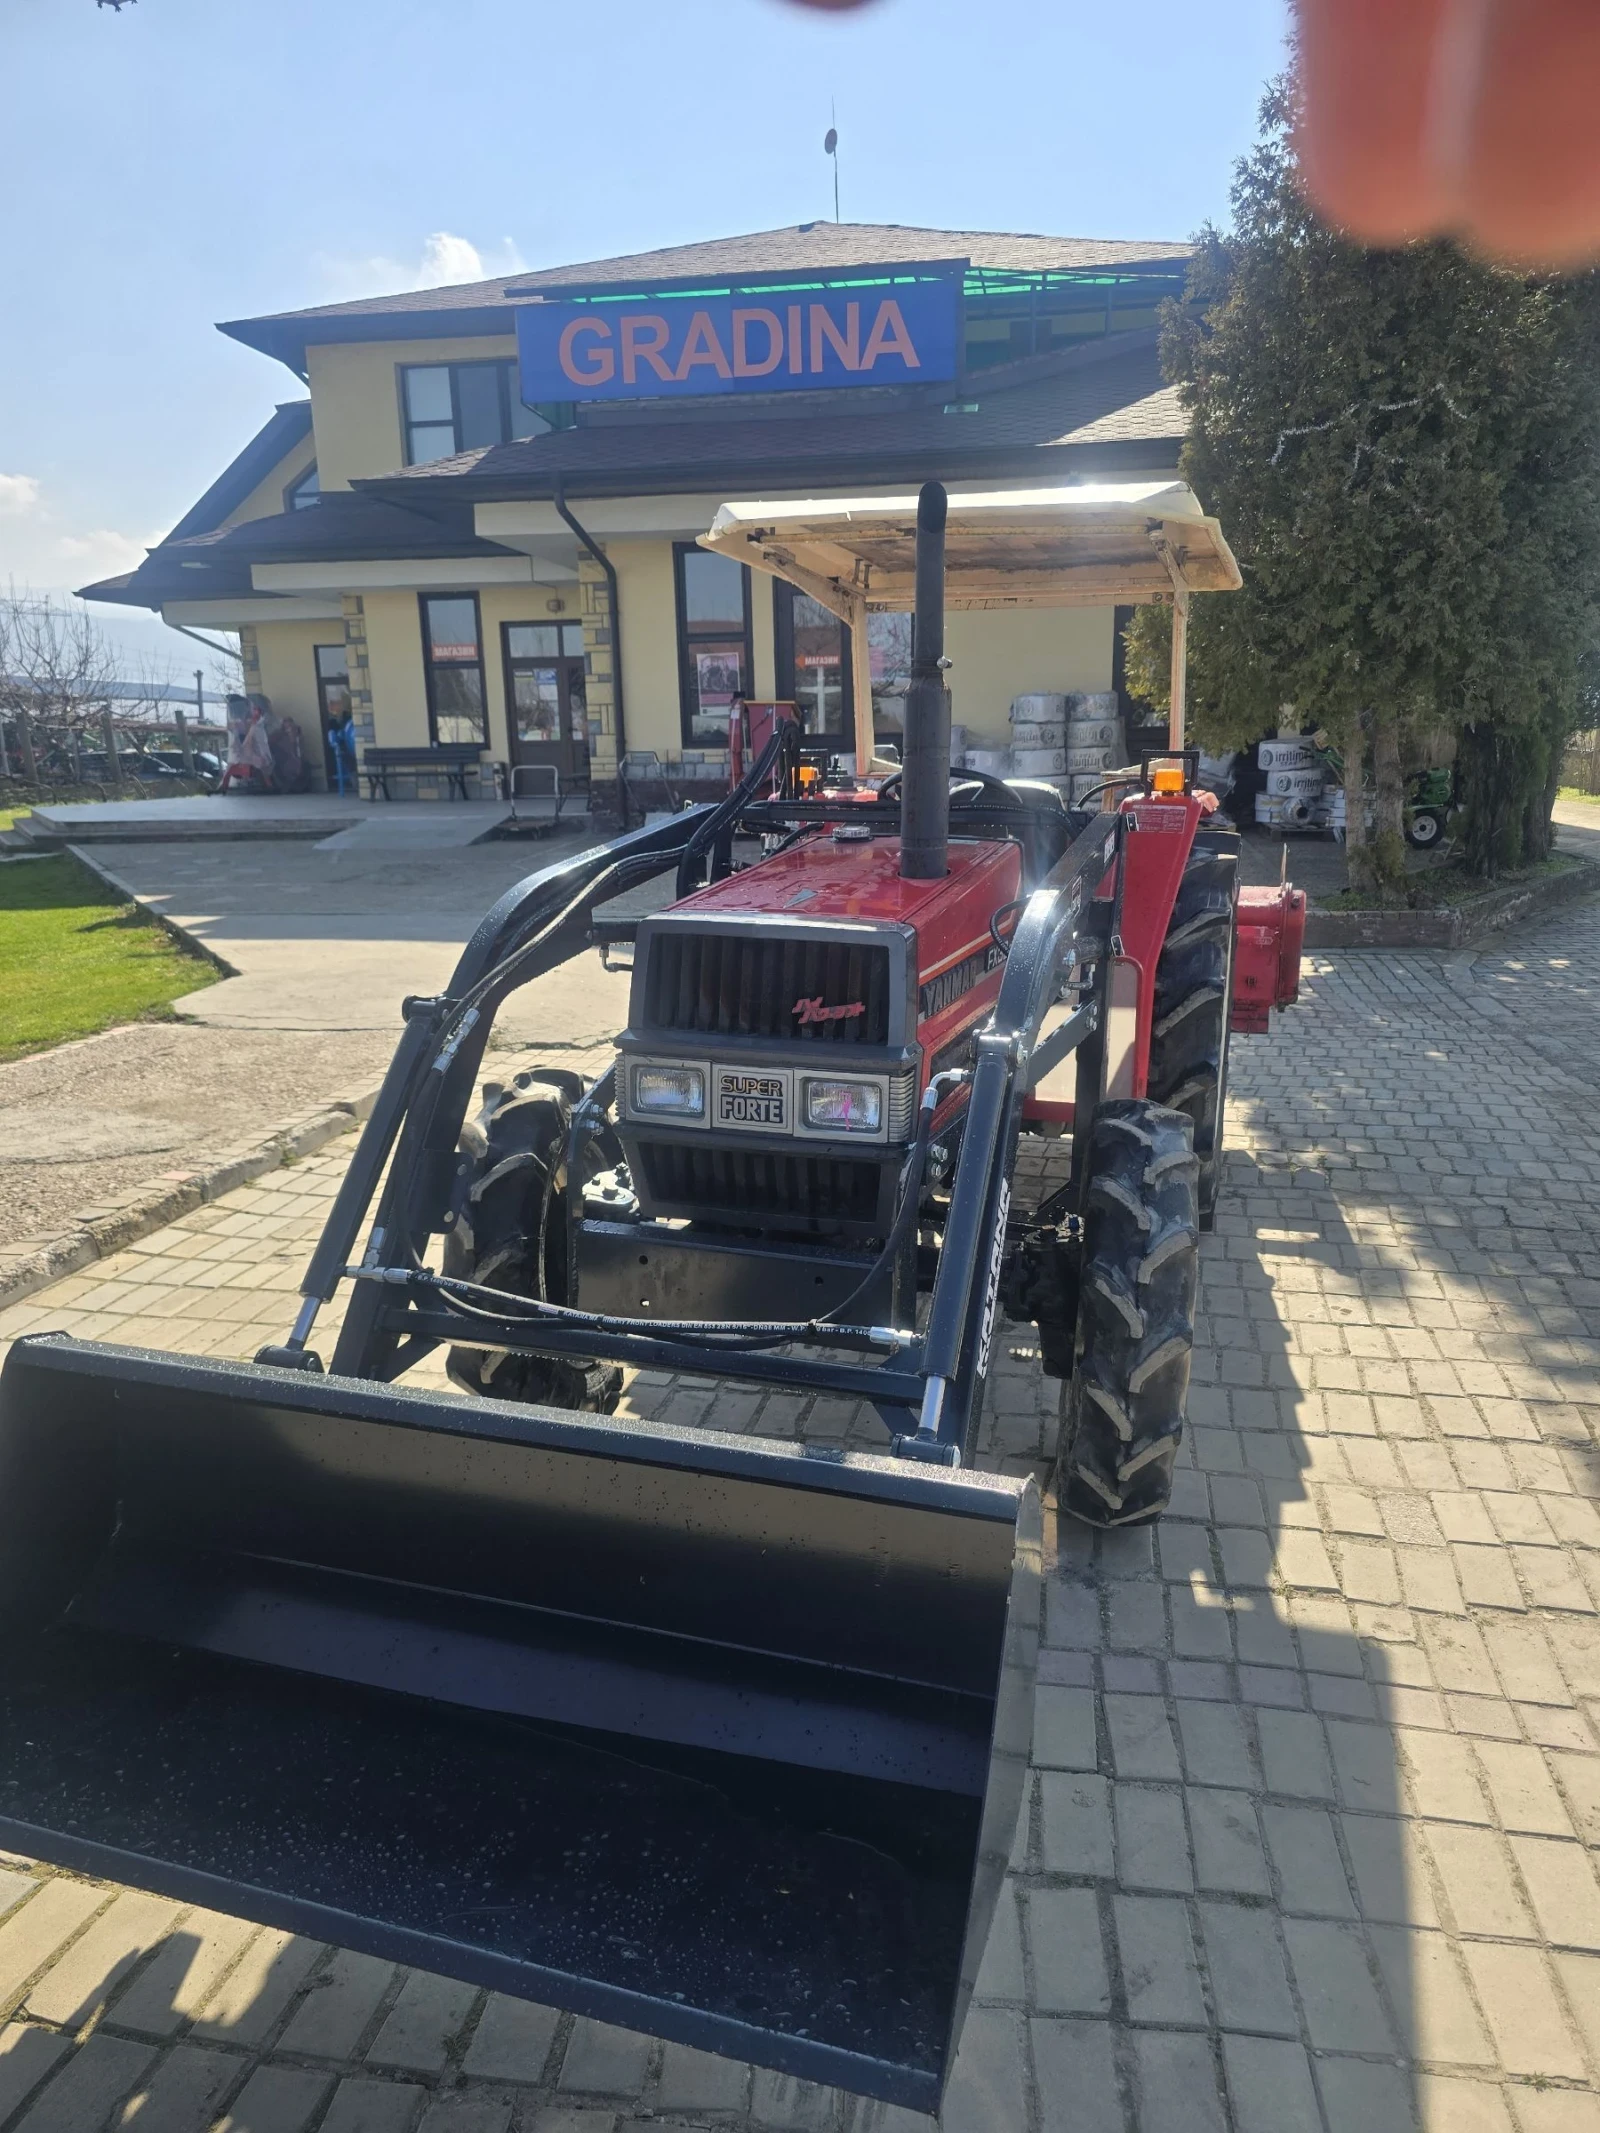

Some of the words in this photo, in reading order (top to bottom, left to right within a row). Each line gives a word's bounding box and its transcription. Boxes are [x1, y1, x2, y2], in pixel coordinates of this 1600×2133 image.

[559, 299, 921, 386] GRADINA
[923, 960, 978, 1019] YANMAR
[721, 1076, 783, 1097] SUPER
[721, 1095, 783, 1123] FORTE
